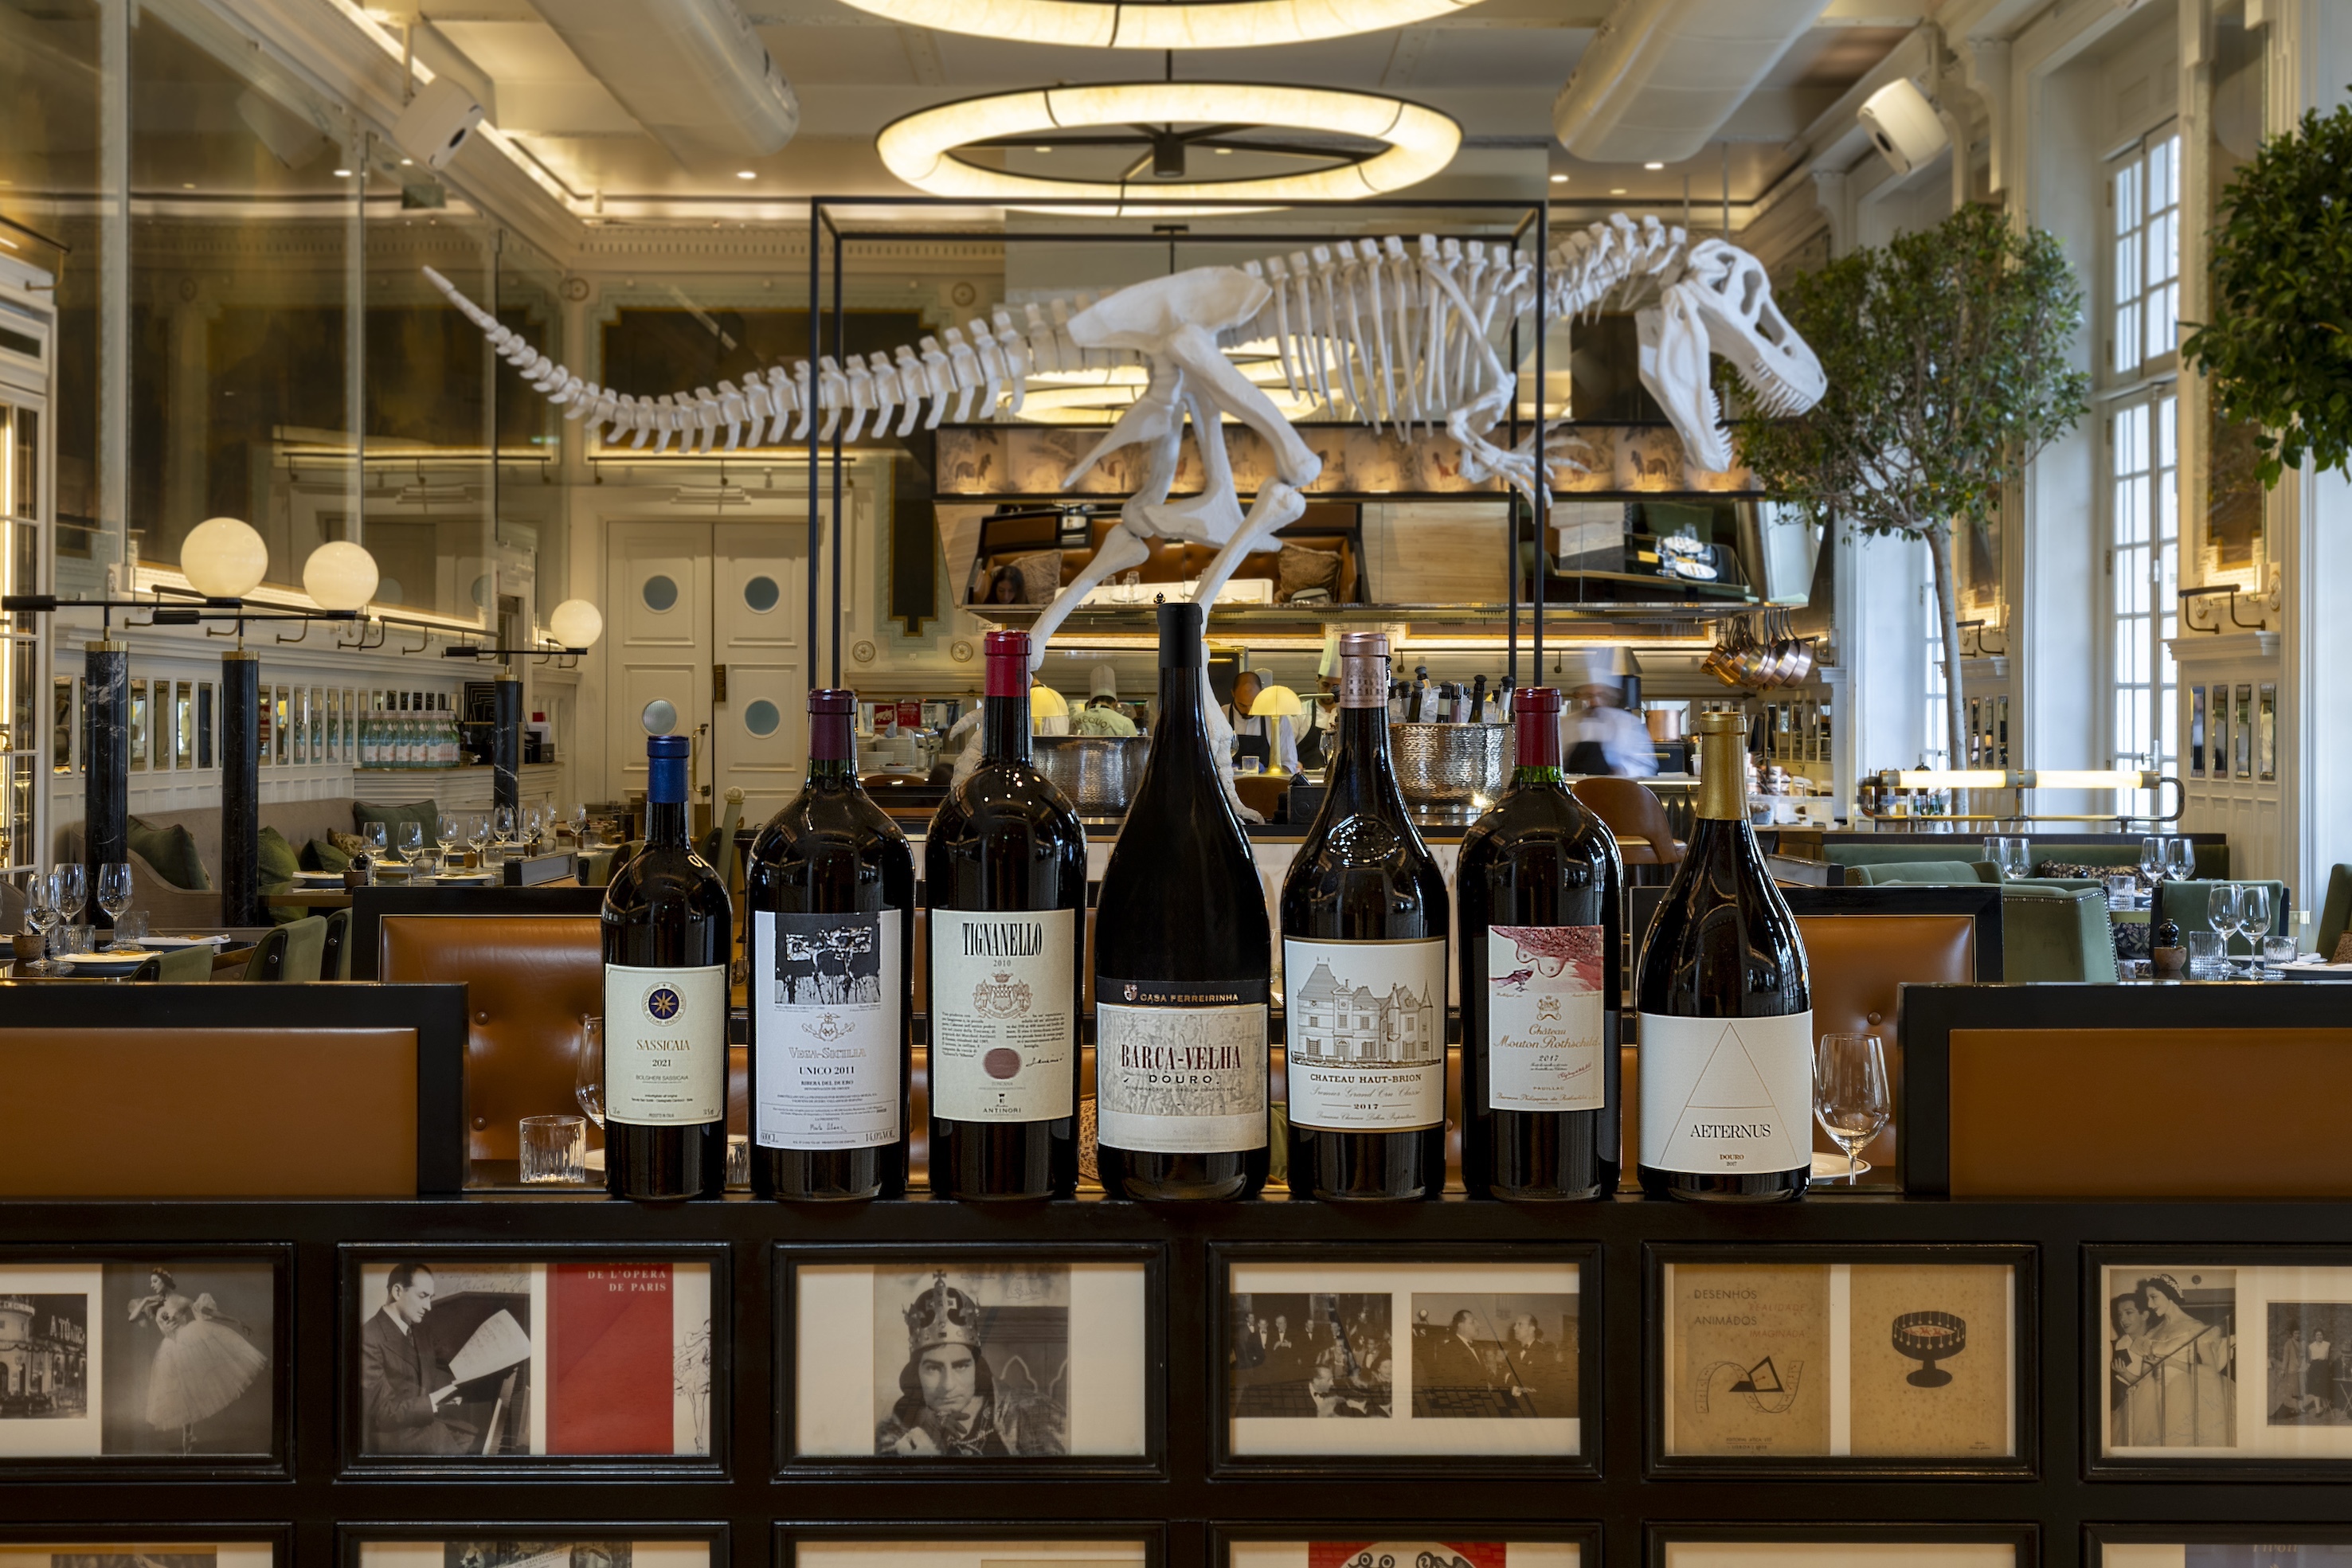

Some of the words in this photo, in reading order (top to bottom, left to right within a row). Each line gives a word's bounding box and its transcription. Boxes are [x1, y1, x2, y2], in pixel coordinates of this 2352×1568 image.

[962, 922, 1042, 956] TIGNANELLO
[1140, 994, 1167, 1003] CASA
[1170, 993, 1239, 1003] FERREIRINHA
[1528, 1023, 1567, 1036] Château
[636, 1039, 691, 1050] SASSICAIA
[1493, 1035, 1539, 1049] Mouton
[799, 1066, 832, 1075] UNICO
[834, 1066, 855, 1075] 2011
[1310, 1073, 1355, 1083] CHATEAU
[1359, 1073, 1422, 1083] HAUT-BRION
[1344, 1087, 1376, 1098] Grand
[1377, 1087, 1394, 1098] Cru
[1690, 1124, 1771, 1139] AETERNUS
[631, 1283, 666, 1292] PARIS
[1694, 1289, 1757, 1300] DESENHOS
[1749, 1303, 1806, 1312] REALIDADE
[1694, 1316, 1757, 1326] ANIMADOS
